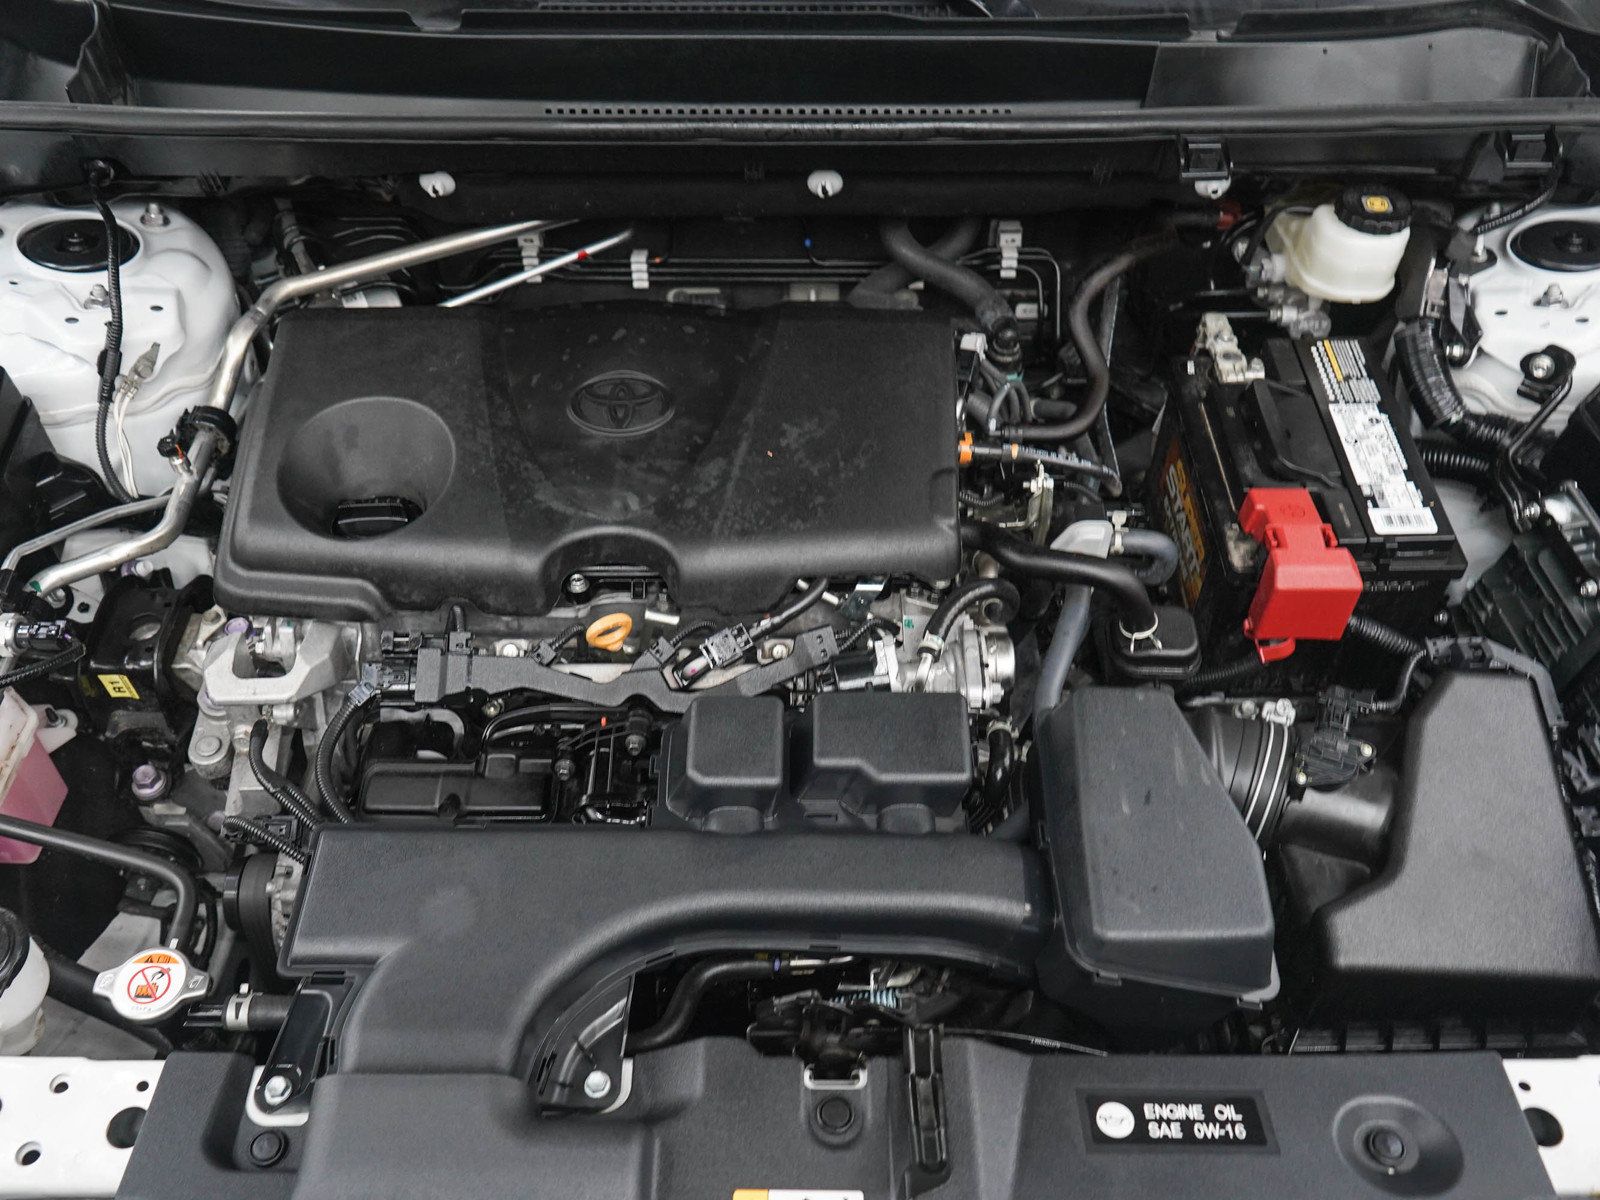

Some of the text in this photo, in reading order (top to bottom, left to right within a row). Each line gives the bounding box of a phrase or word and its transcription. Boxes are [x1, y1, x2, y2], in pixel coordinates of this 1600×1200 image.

[1143, 1103, 1243, 1121] ENGINE OIL
[1148, 1121, 1247, 1140] SAE 0W-16
